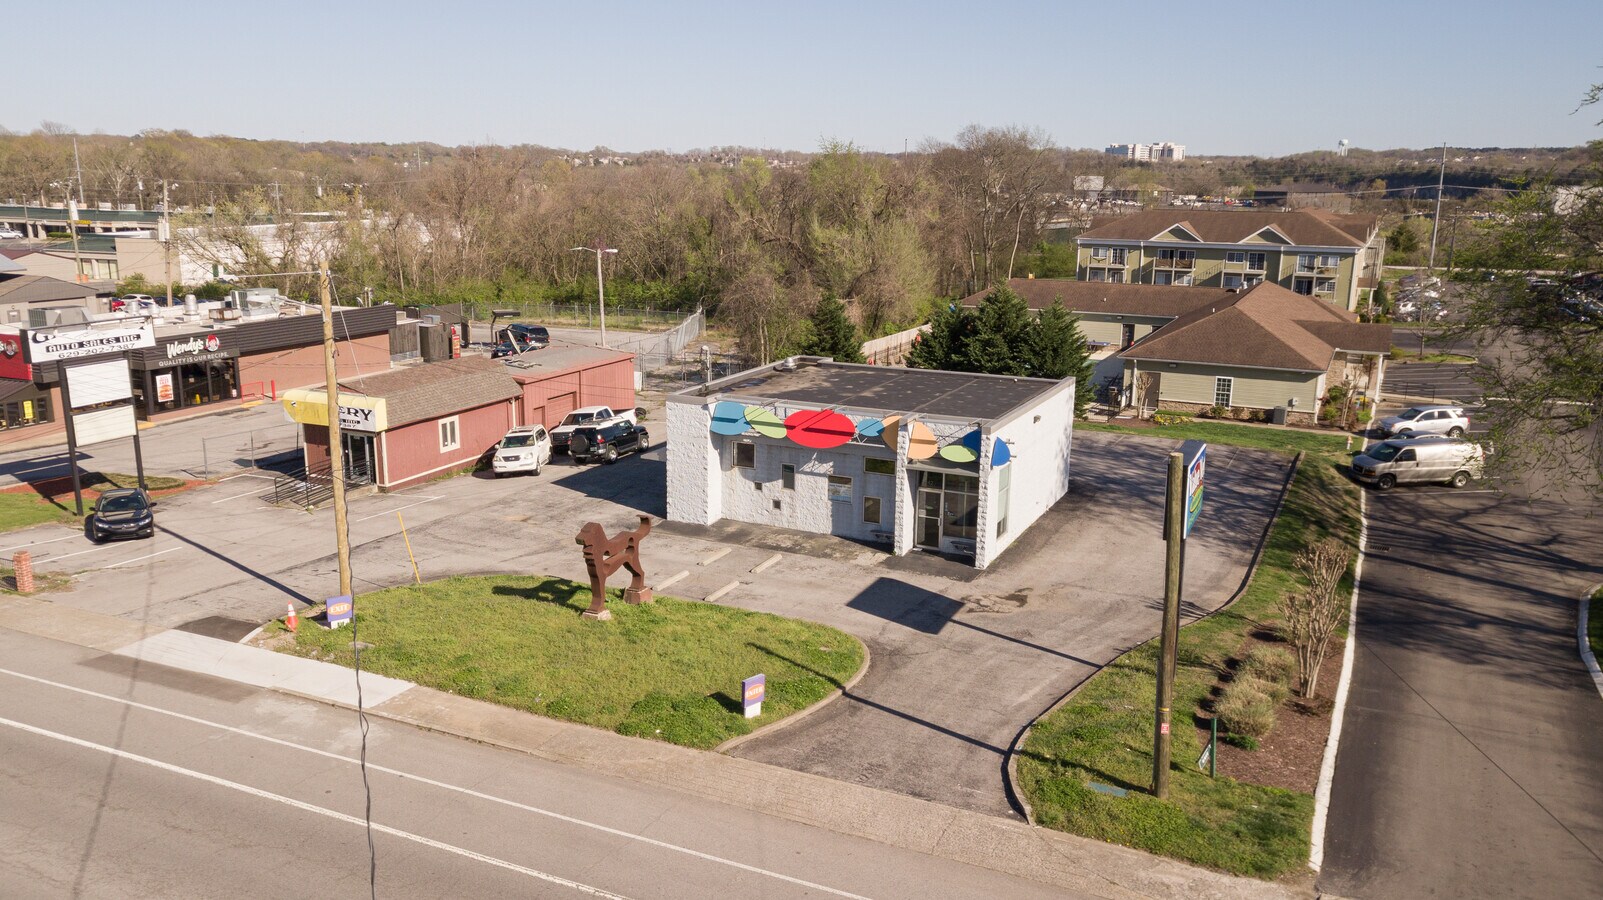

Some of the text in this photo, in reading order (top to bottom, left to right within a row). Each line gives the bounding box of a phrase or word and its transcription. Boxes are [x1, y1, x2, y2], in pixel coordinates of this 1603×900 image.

[48, 342, 79, 352] AUTO
[83, 337, 116, 348] SALES
[58, 343, 136, 358] 629-202-7387
[166, 337, 204, 358] Wendy's
[158, 358, 186, 367] QUALITY
[193, 354, 207, 362] OUR
[330, 604, 348, 613] EXIT
[745, 686, 763, 697] ENTER
